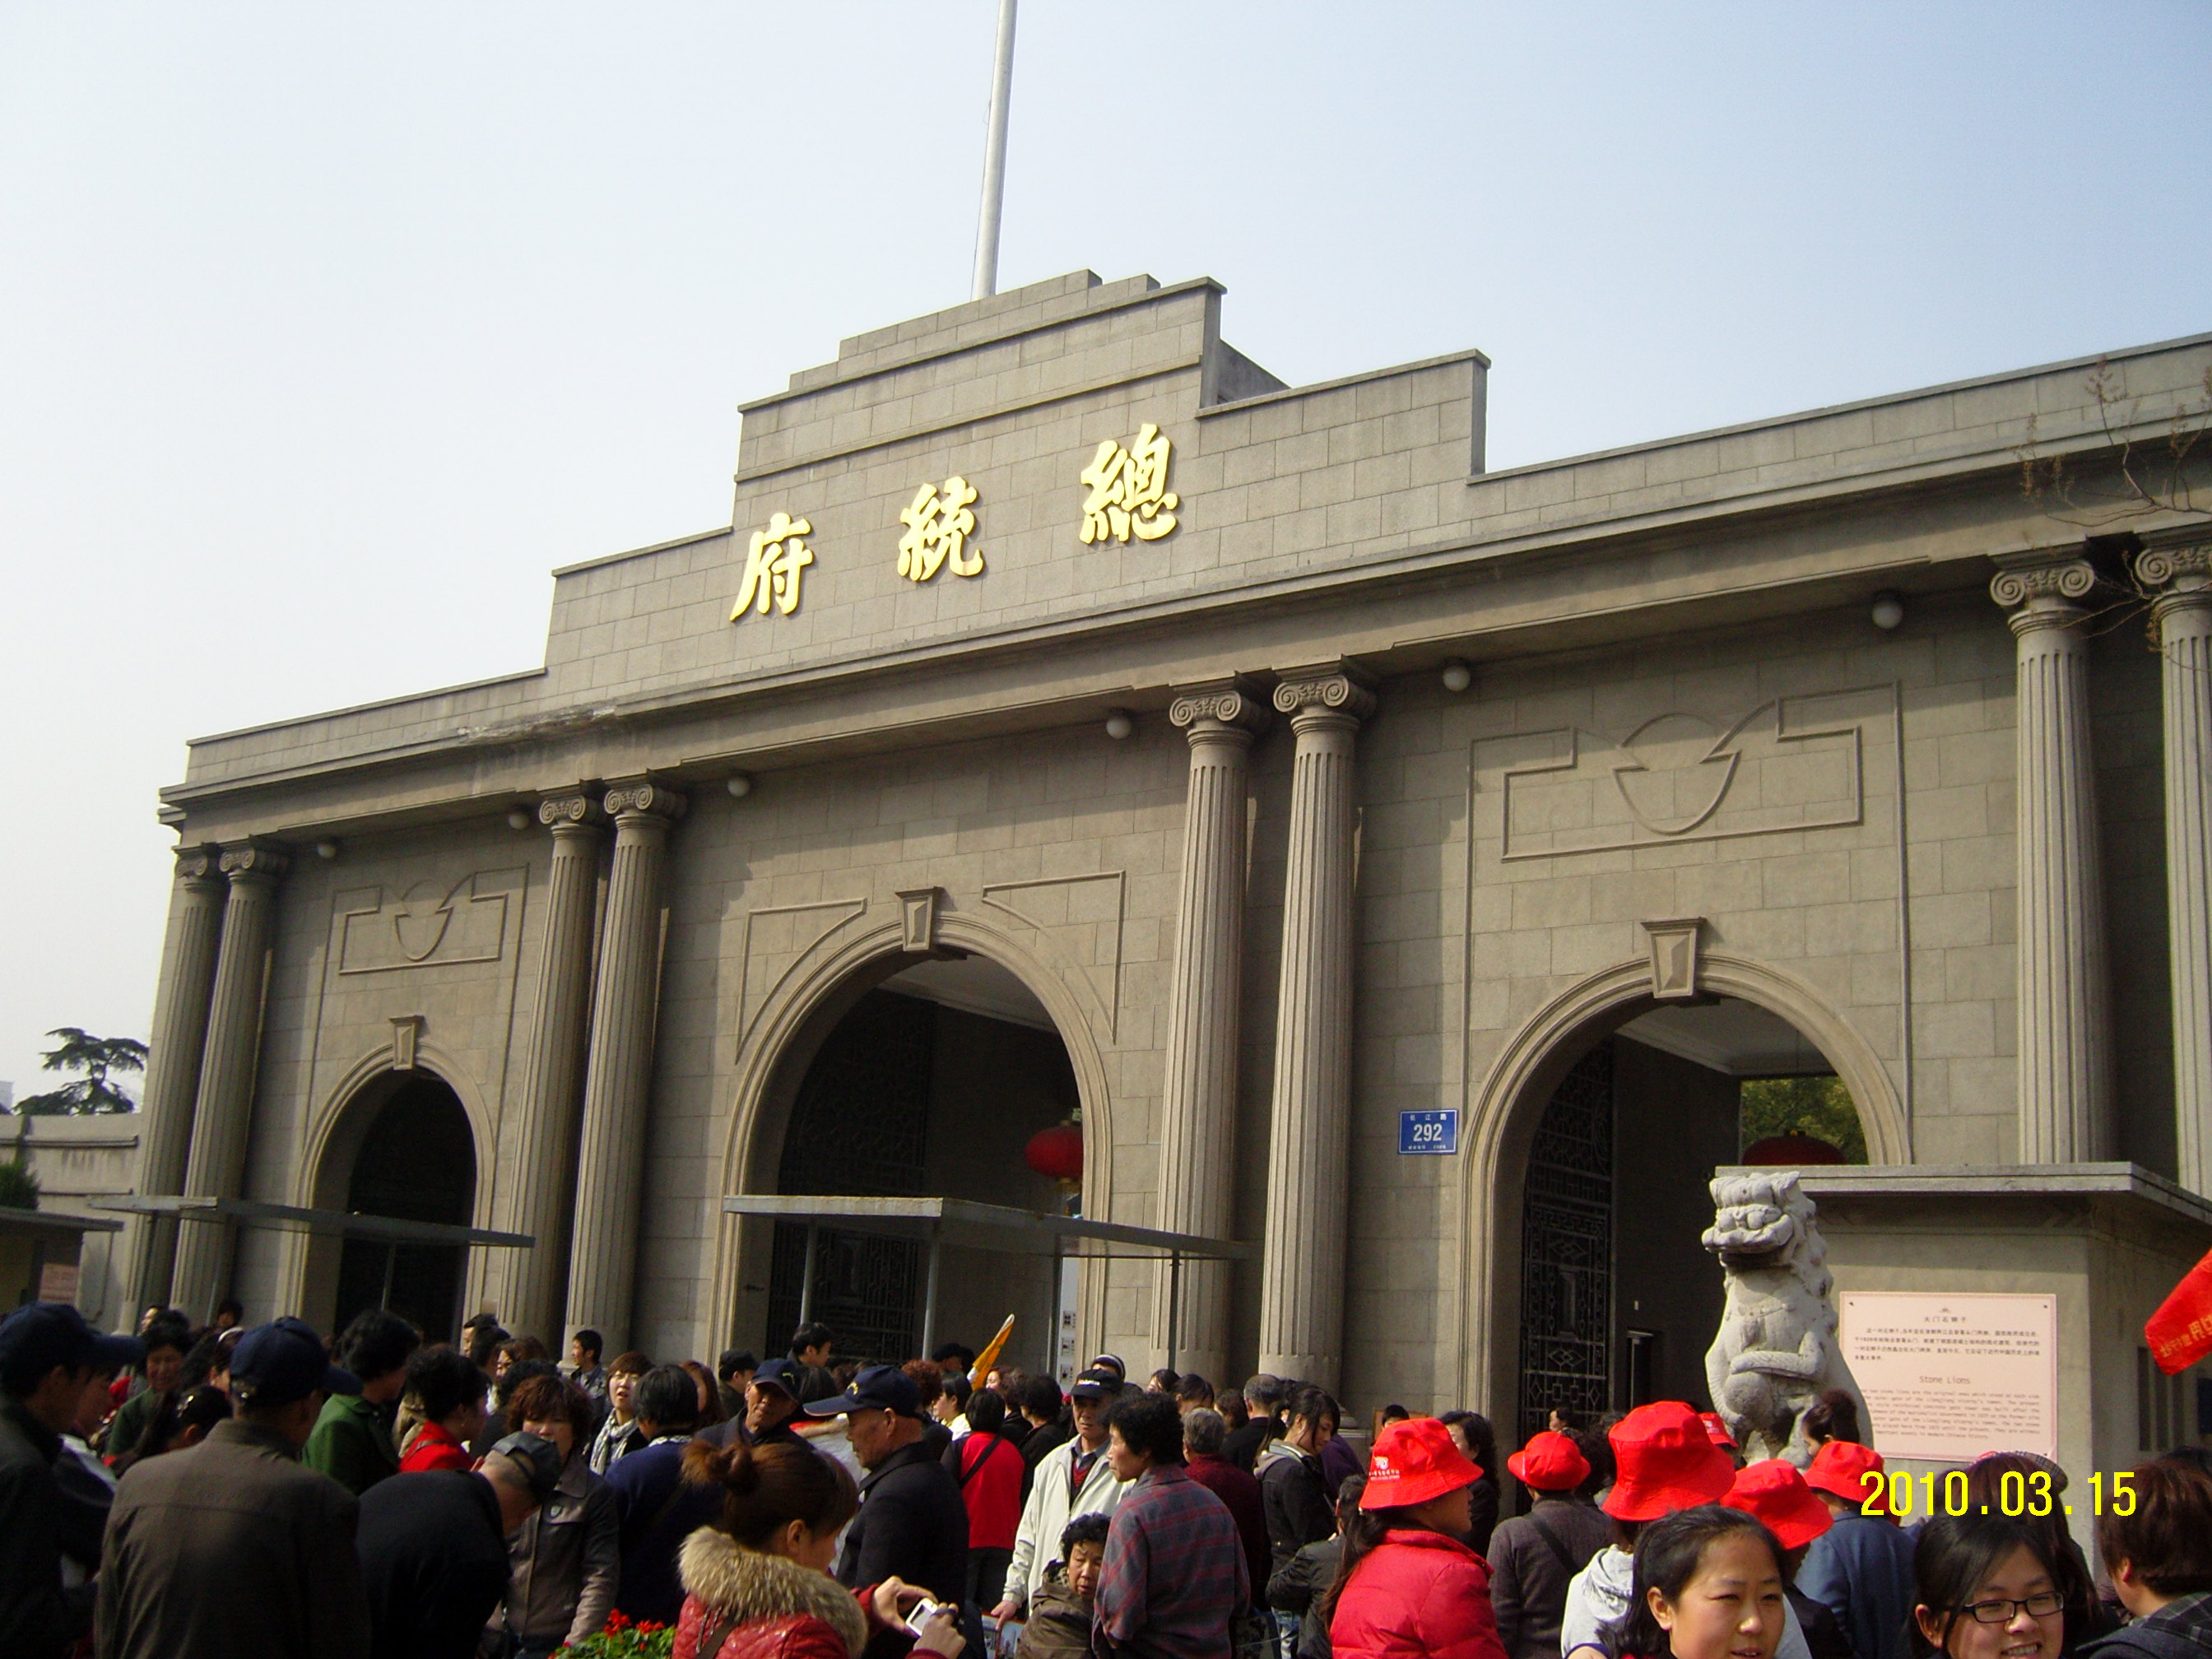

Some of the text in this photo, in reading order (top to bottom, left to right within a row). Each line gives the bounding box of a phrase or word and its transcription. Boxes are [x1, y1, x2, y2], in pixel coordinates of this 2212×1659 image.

[1413, 1123, 1443, 1141] 292
[1919, 1375, 1971, 1385] Stone Lions
